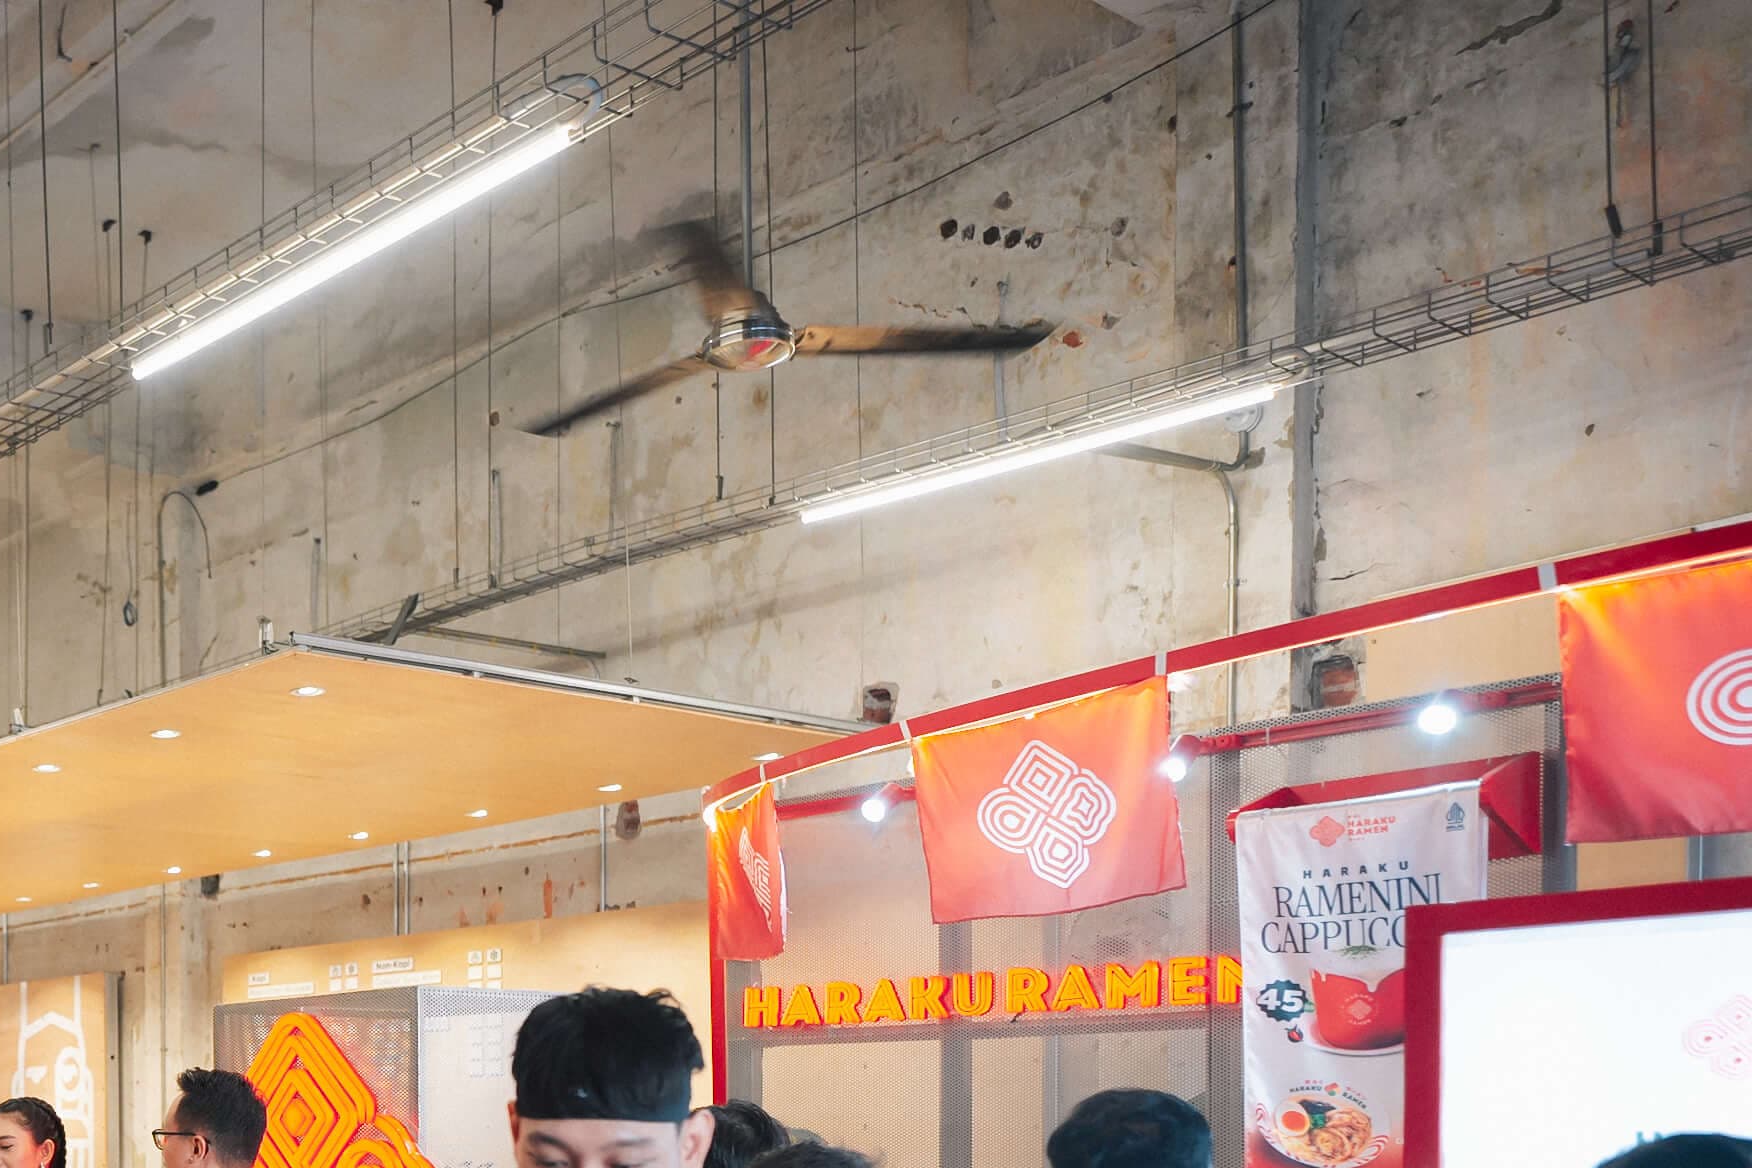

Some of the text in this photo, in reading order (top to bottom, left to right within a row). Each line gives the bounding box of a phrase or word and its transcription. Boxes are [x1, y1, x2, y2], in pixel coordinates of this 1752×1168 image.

[1348, 815, 1396, 828] HARAKU
[1348, 825, 1389, 837] RAMEN
[1303, 861, 1409, 879] HARAKU
[1272, 873, 1441, 918] RAMENINI
[743, 955, 1244, 1028] HARAKU RAMEN
[1256, 988, 1304, 1013] 45
